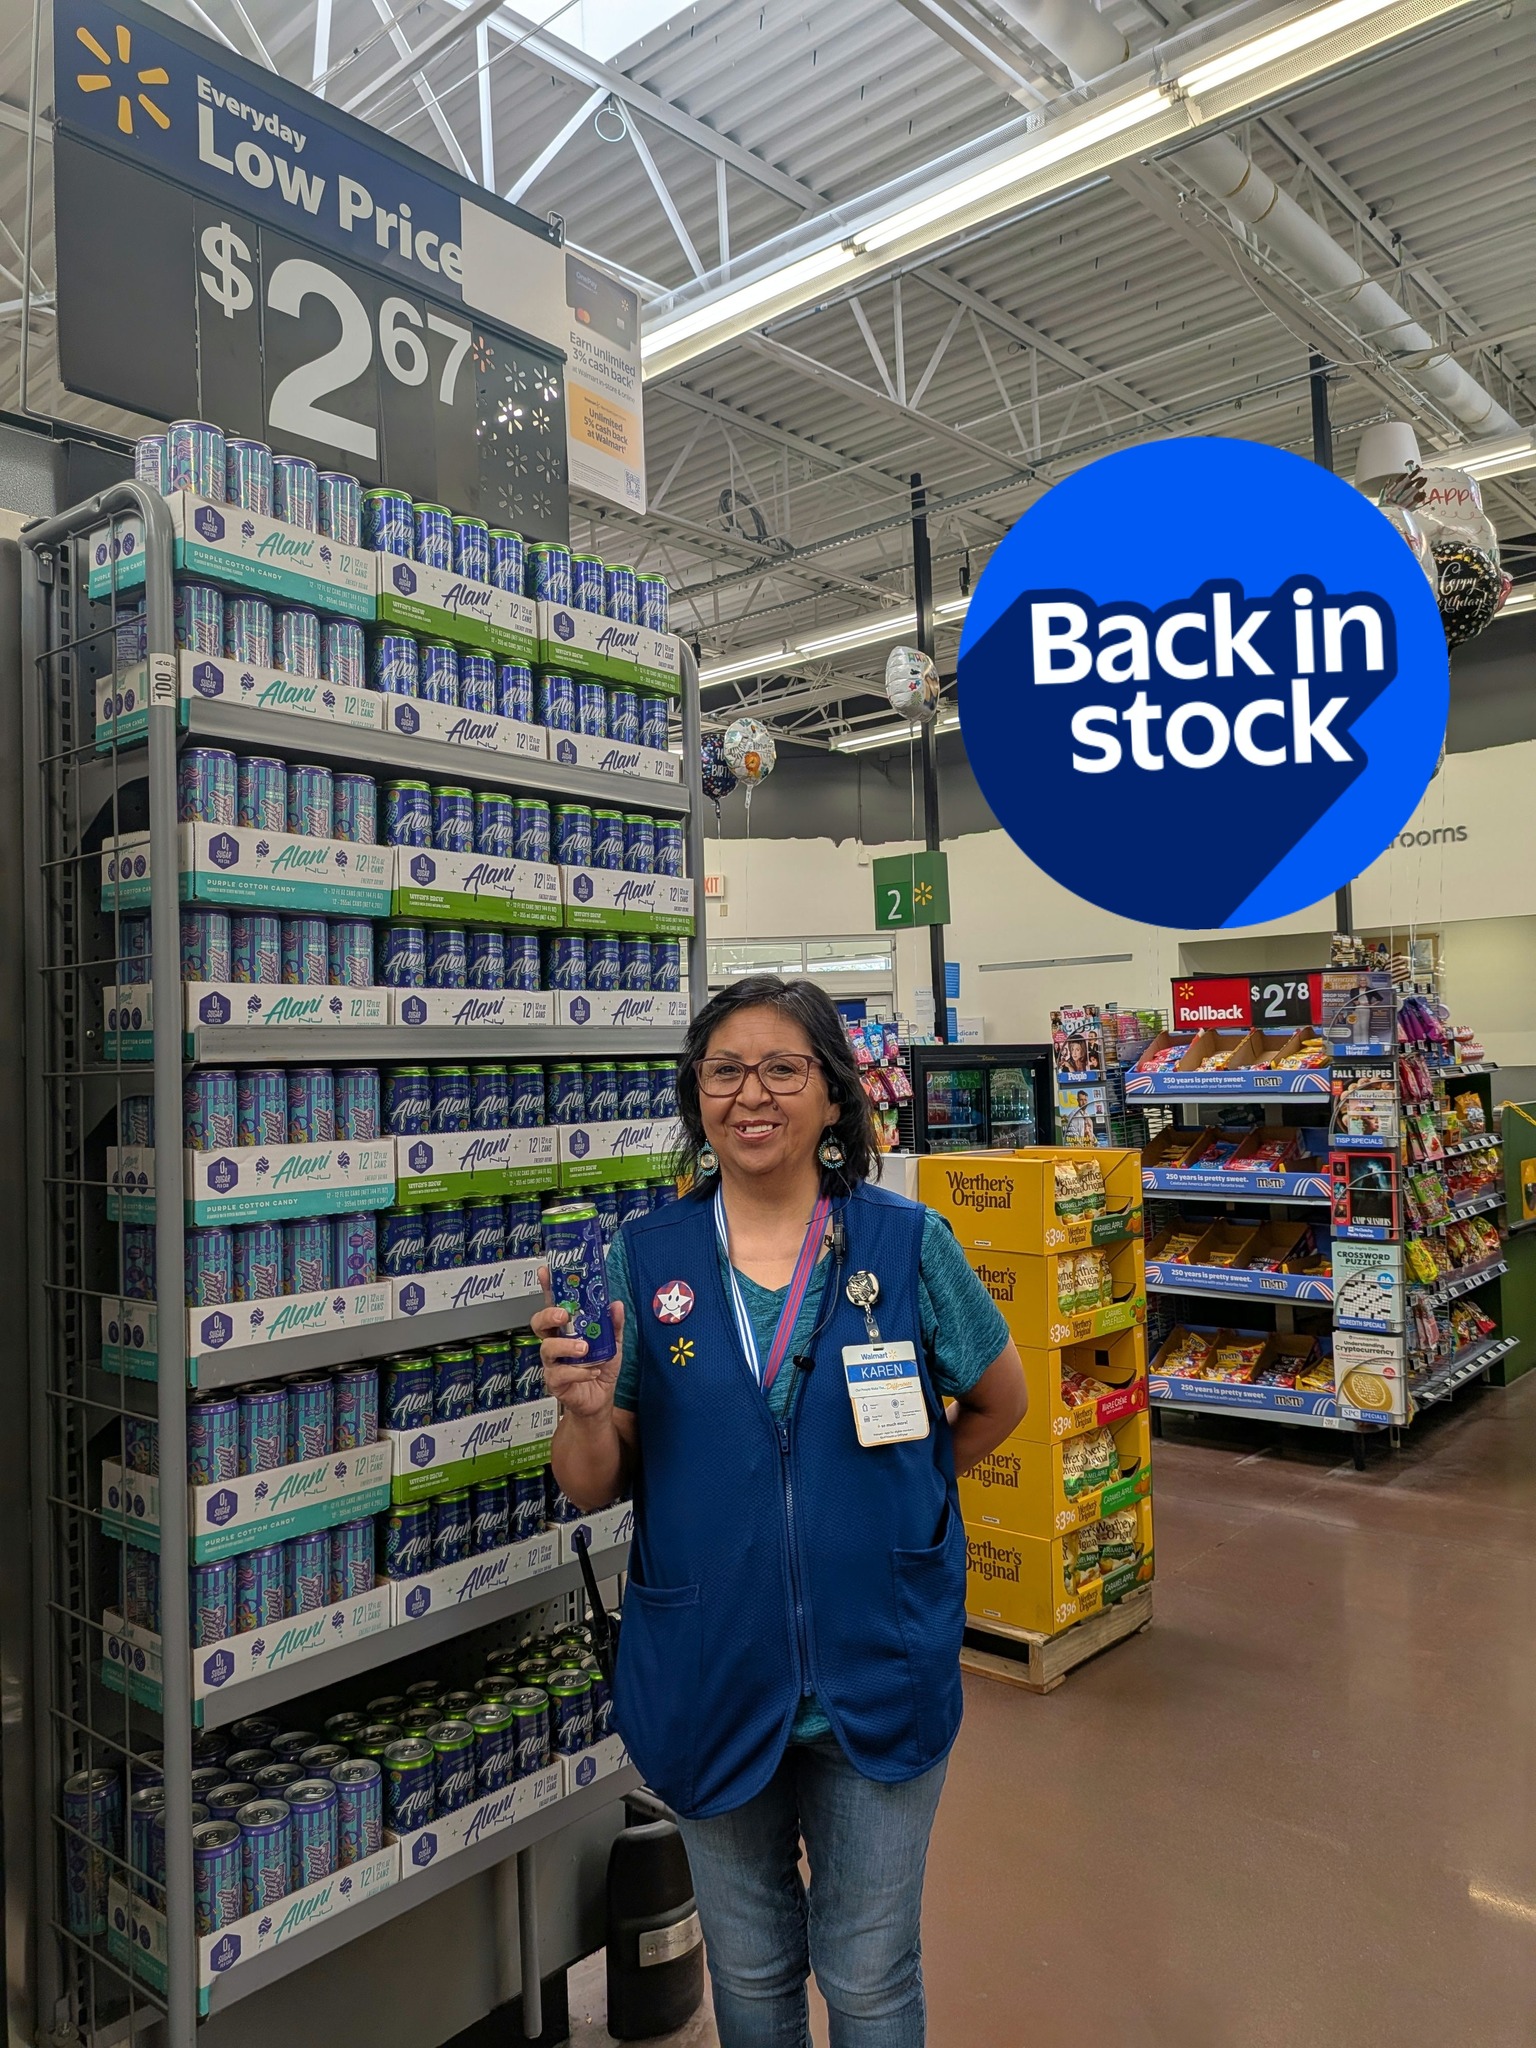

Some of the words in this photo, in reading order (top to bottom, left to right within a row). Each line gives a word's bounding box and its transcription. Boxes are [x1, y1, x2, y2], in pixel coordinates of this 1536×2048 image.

[196, 74, 307, 153] Everyday
[198, 103, 326, 215] Low
[338, 174, 464, 285] Price
[570, 332, 592, 352] Earn
[593, 345, 635, 377] unlimited
[573, 348, 587, 364] 3%
[588, 357, 610, 376] cash
[589, 408, 622, 432] Unlimited
[584, 416, 594, 428] 5%
[595, 424, 611, 437] cash
[612, 429, 628, 445] back
[587, 430, 594, 439] at
[202, 522, 219, 535] SUGAR
[256, 532, 315, 559] Alani
[194, 551, 224, 566] PURPLE
[225, 558, 255, 573] COTTON
[257, 567, 282, 581] CANDY
[339, 554, 350, 572] 12
[355, 567, 368, 579] CANS
[442, 583, 493, 621] Alani
[595, 626, 640, 661] Alani
[156, 671, 172, 699] 100
[201, 678, 217, 690] SUGAR
[256, 680, 318, 708] Alani
[344, 697, 356, 714] 12
[361, 706, 374, 719] CANS
[445, 717, 499, 743] Alani
[1385, 825, 1468, 849] rooms
[216, 850, 233, 859] SUGAR
[270, 845, 331, 874] Alani
[355, 854, 367, 872] 12
[371, 864, 384, 874] CANS
[207, 879, 236, 888] PURPLE
[238, 882, 268, 891] COTTON
[270, 884, 296, 893] CANDY
[462, 863, 517, 902] Alani
[613, 880, 656, 916] Alani
[886, 888, 902, 920] 2
[207, 1009, 223, 1019] SUGAR
[262, 994, 324, 1025] Alani
[350, 999, 362, 1017] 12
[366, 1007, 379, 1017] CANS
[452, 996, 505, 1025] Alani
[1063, 1010, 1084, 1019] People
[1180, 1005, 1243, 1021] Rollback
[934, 1074, 952, 1083] pepsi
[1068, 1073, 1087, 1081] People
[1332, 1070, 1353, 1078] FALL
[1355, 1070, 1392, 1078] RECIPES
[1059, 1091, 1078, 1108] Us
[358, 1152, 368, 1170] 12
[373, 1160, 387, 1170] CANS
[459, 1133, 512, 1179] Alani
[271, 1150, 333, 1189] Alani
[215, 1174, 231, 1185] SUGAR
[946, 1170, 1014, 1192] Werther's
[1204, 1175, 1225, 1183] pretty
[207, 1204, 236, 1213] PURPLE
[239, 1201, 271, 1210] COTTON
[272, 1198, 298, 1207] CANDY
[952, 1189, 1011, 1212] Original
[1067, 1226, 1087, 1237] Werther's
[1069, 1232, 1087, 1245] Original
[1337, 1251, 1390, 1260] CROSSWORD
[1345, 1258, 1382, 1266] PUZZLES
[975, 1265, 1017, 1285] ther's
[1183, 1270, 1201, 1279] years
[1209, 1272, 1229, 1281] pretty
[1230, 1274, 1252, 1283] sweet.
[354, 1296, 365, 1314] 12
[370, 1300, 383, 1312] CANS
[1104, 1308, 1122, 1319] CARAMEL
[266, 1297, 327, 1340] Alani
[208, 1328, 225, 1338] SUGAR
[1335, 1345, 1394, 1356] Cryptocurrency
[1344, 1340, 1384, 1349] Understanding
[861, 1352, 888, 1360] Walmart
[861, 1364, 903, 1379] KAREN
[1194, 1386, 1213, 1395] years
[1220, 1388, 1242, 1397] pretty
[1243, 1390, 1267, 1399] sweet.
[1344, 1409, 1359, 1417] SPC
[1362, 1412, 1386, 1420] SPECIALS
[461, 1412, 514, 1464] Alani
[269, 1462, 330, 1511] Alani
[205, 1534, 235, 1548] PURPLE
[237, 1525, 268, 1540] COTTON
[270, 1516, 296, 1530] CANDY
[266, 1614, 327, 1670] Alani
[463, 1787, 516, 1846] Alani
[273, 1880, 335, 1943] Alani
